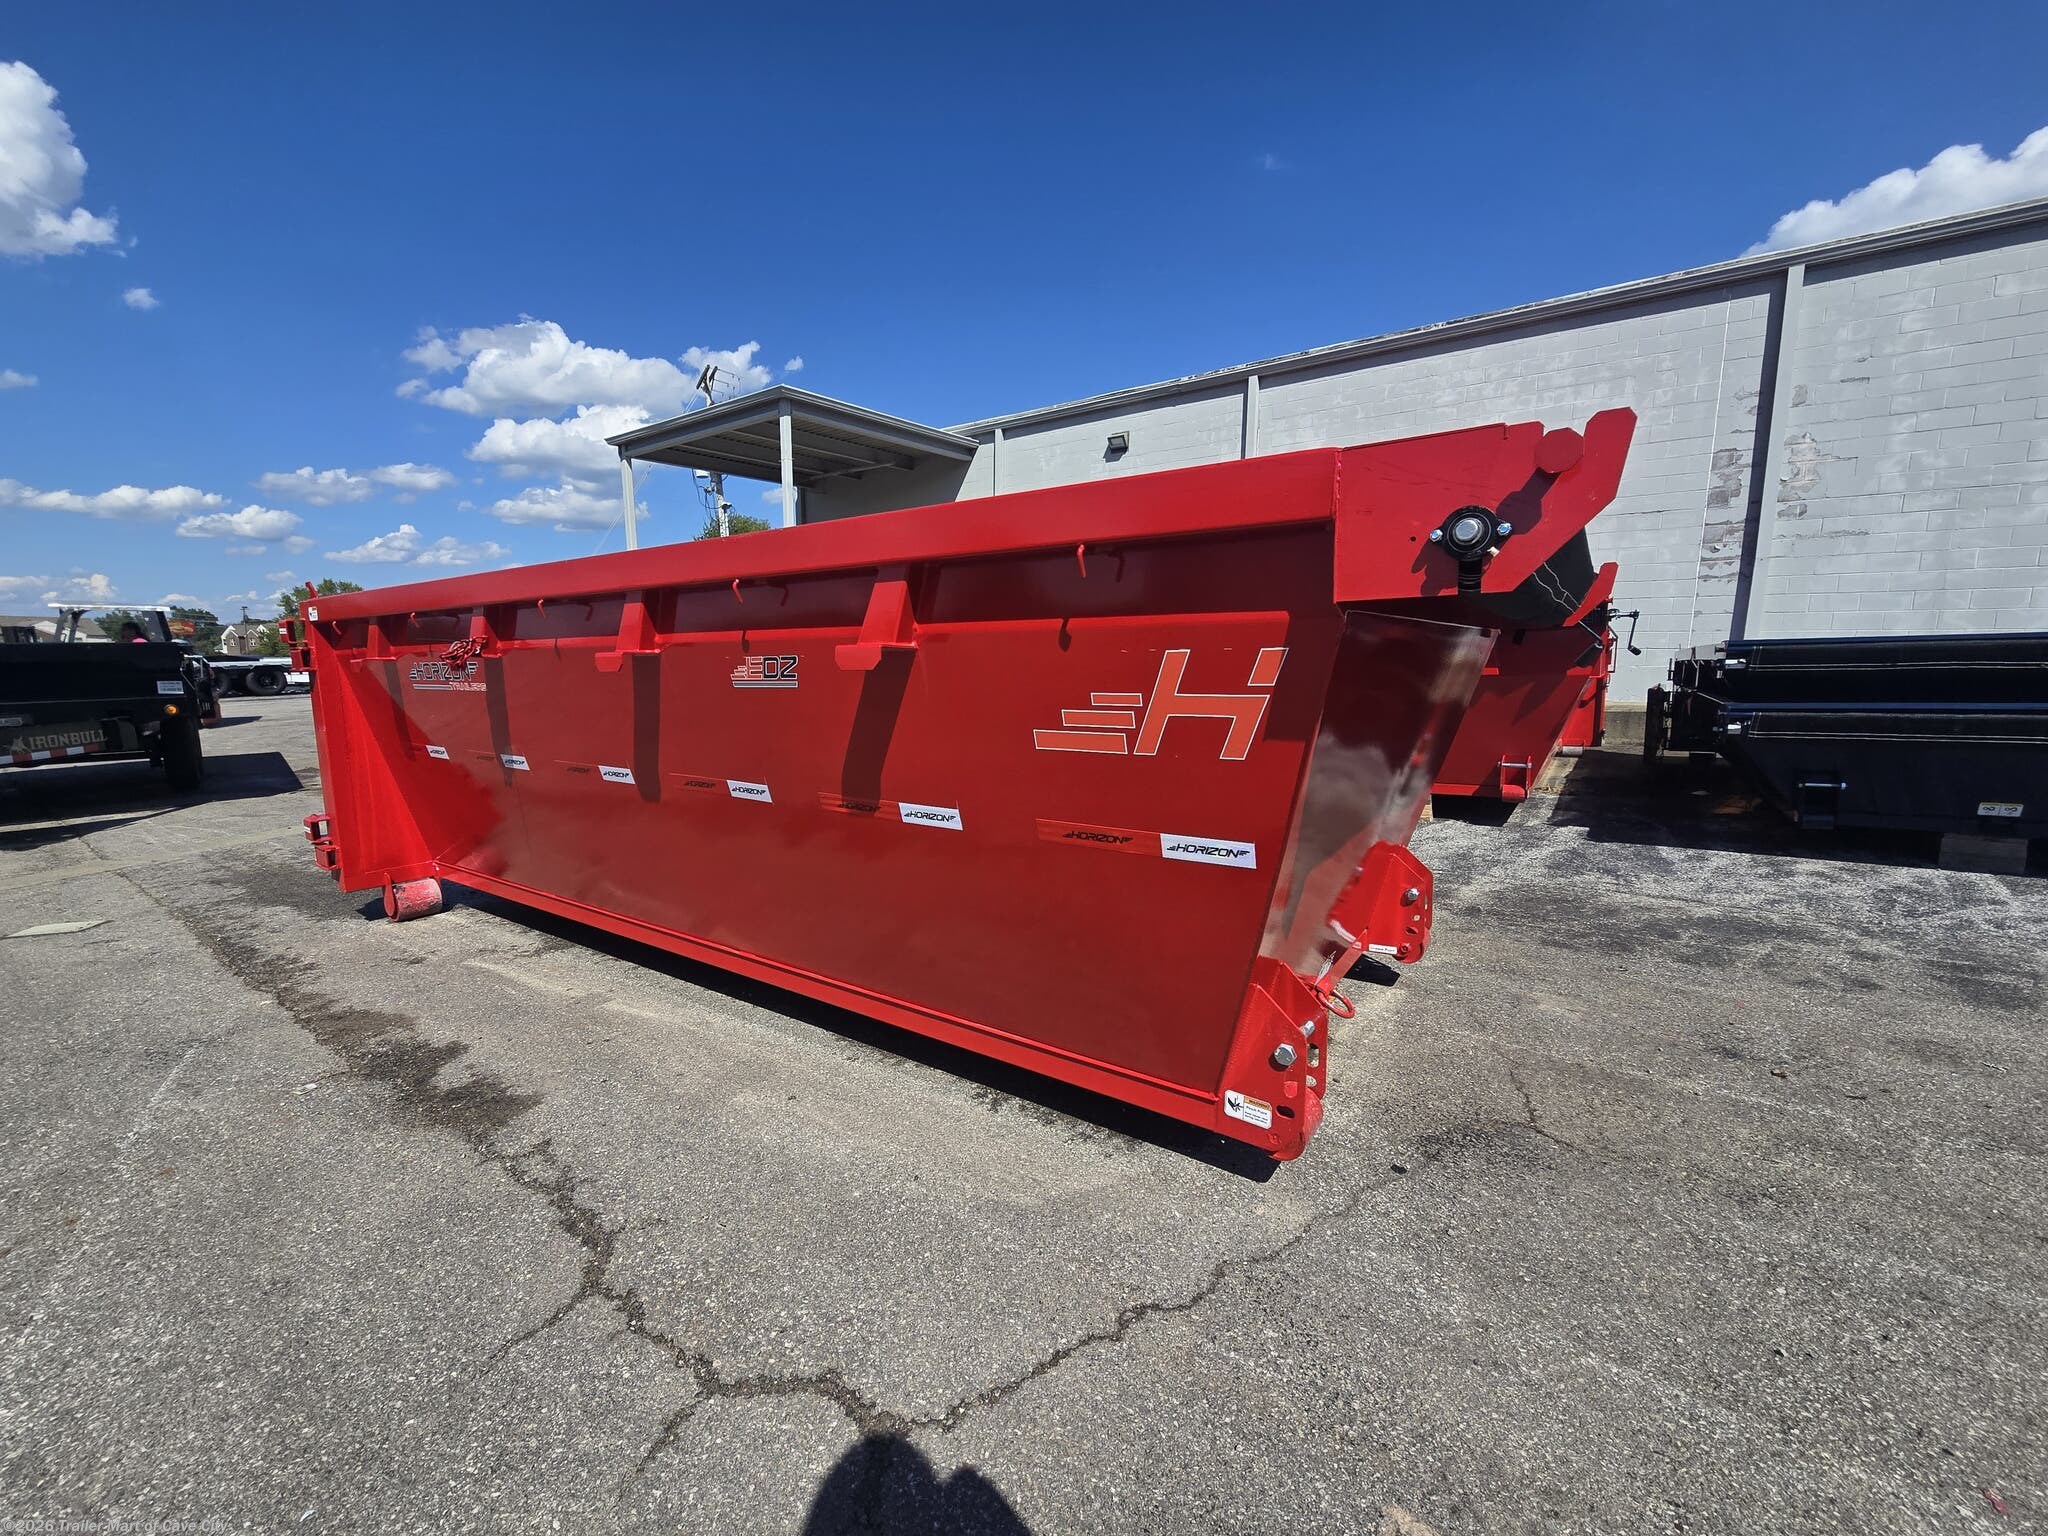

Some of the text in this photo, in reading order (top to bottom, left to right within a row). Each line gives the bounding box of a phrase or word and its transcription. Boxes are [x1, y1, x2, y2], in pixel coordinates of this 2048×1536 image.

[412, 661, 474, 681] HORIZON
[29, 730, 107, 750] IRONBULL
[734, 786, 764, 796] HORIZON
[908, 810, 951, 822] HORIZON
[1069, 831, 1240, 859] HORIZON HORIZON
